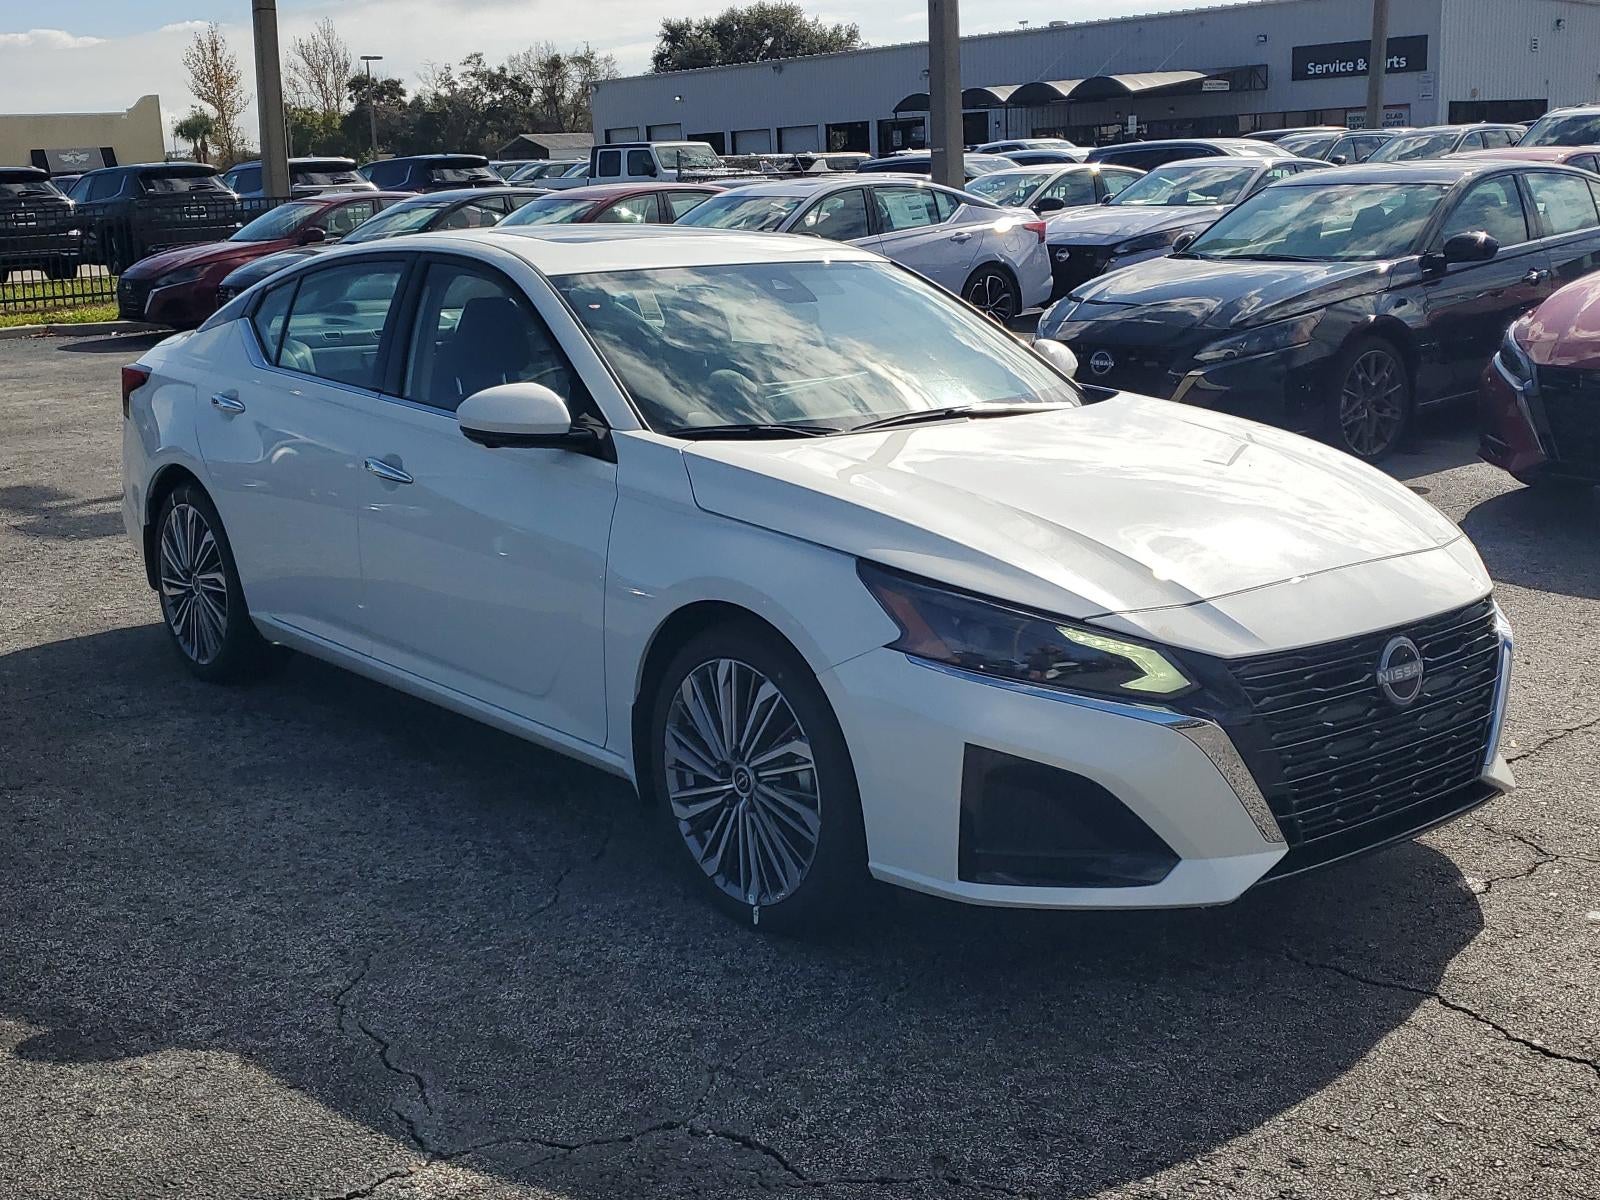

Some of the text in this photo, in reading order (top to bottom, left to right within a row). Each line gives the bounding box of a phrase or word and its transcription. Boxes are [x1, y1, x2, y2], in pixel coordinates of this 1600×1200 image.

[1307, 55, 1406, 74] Service & rts
